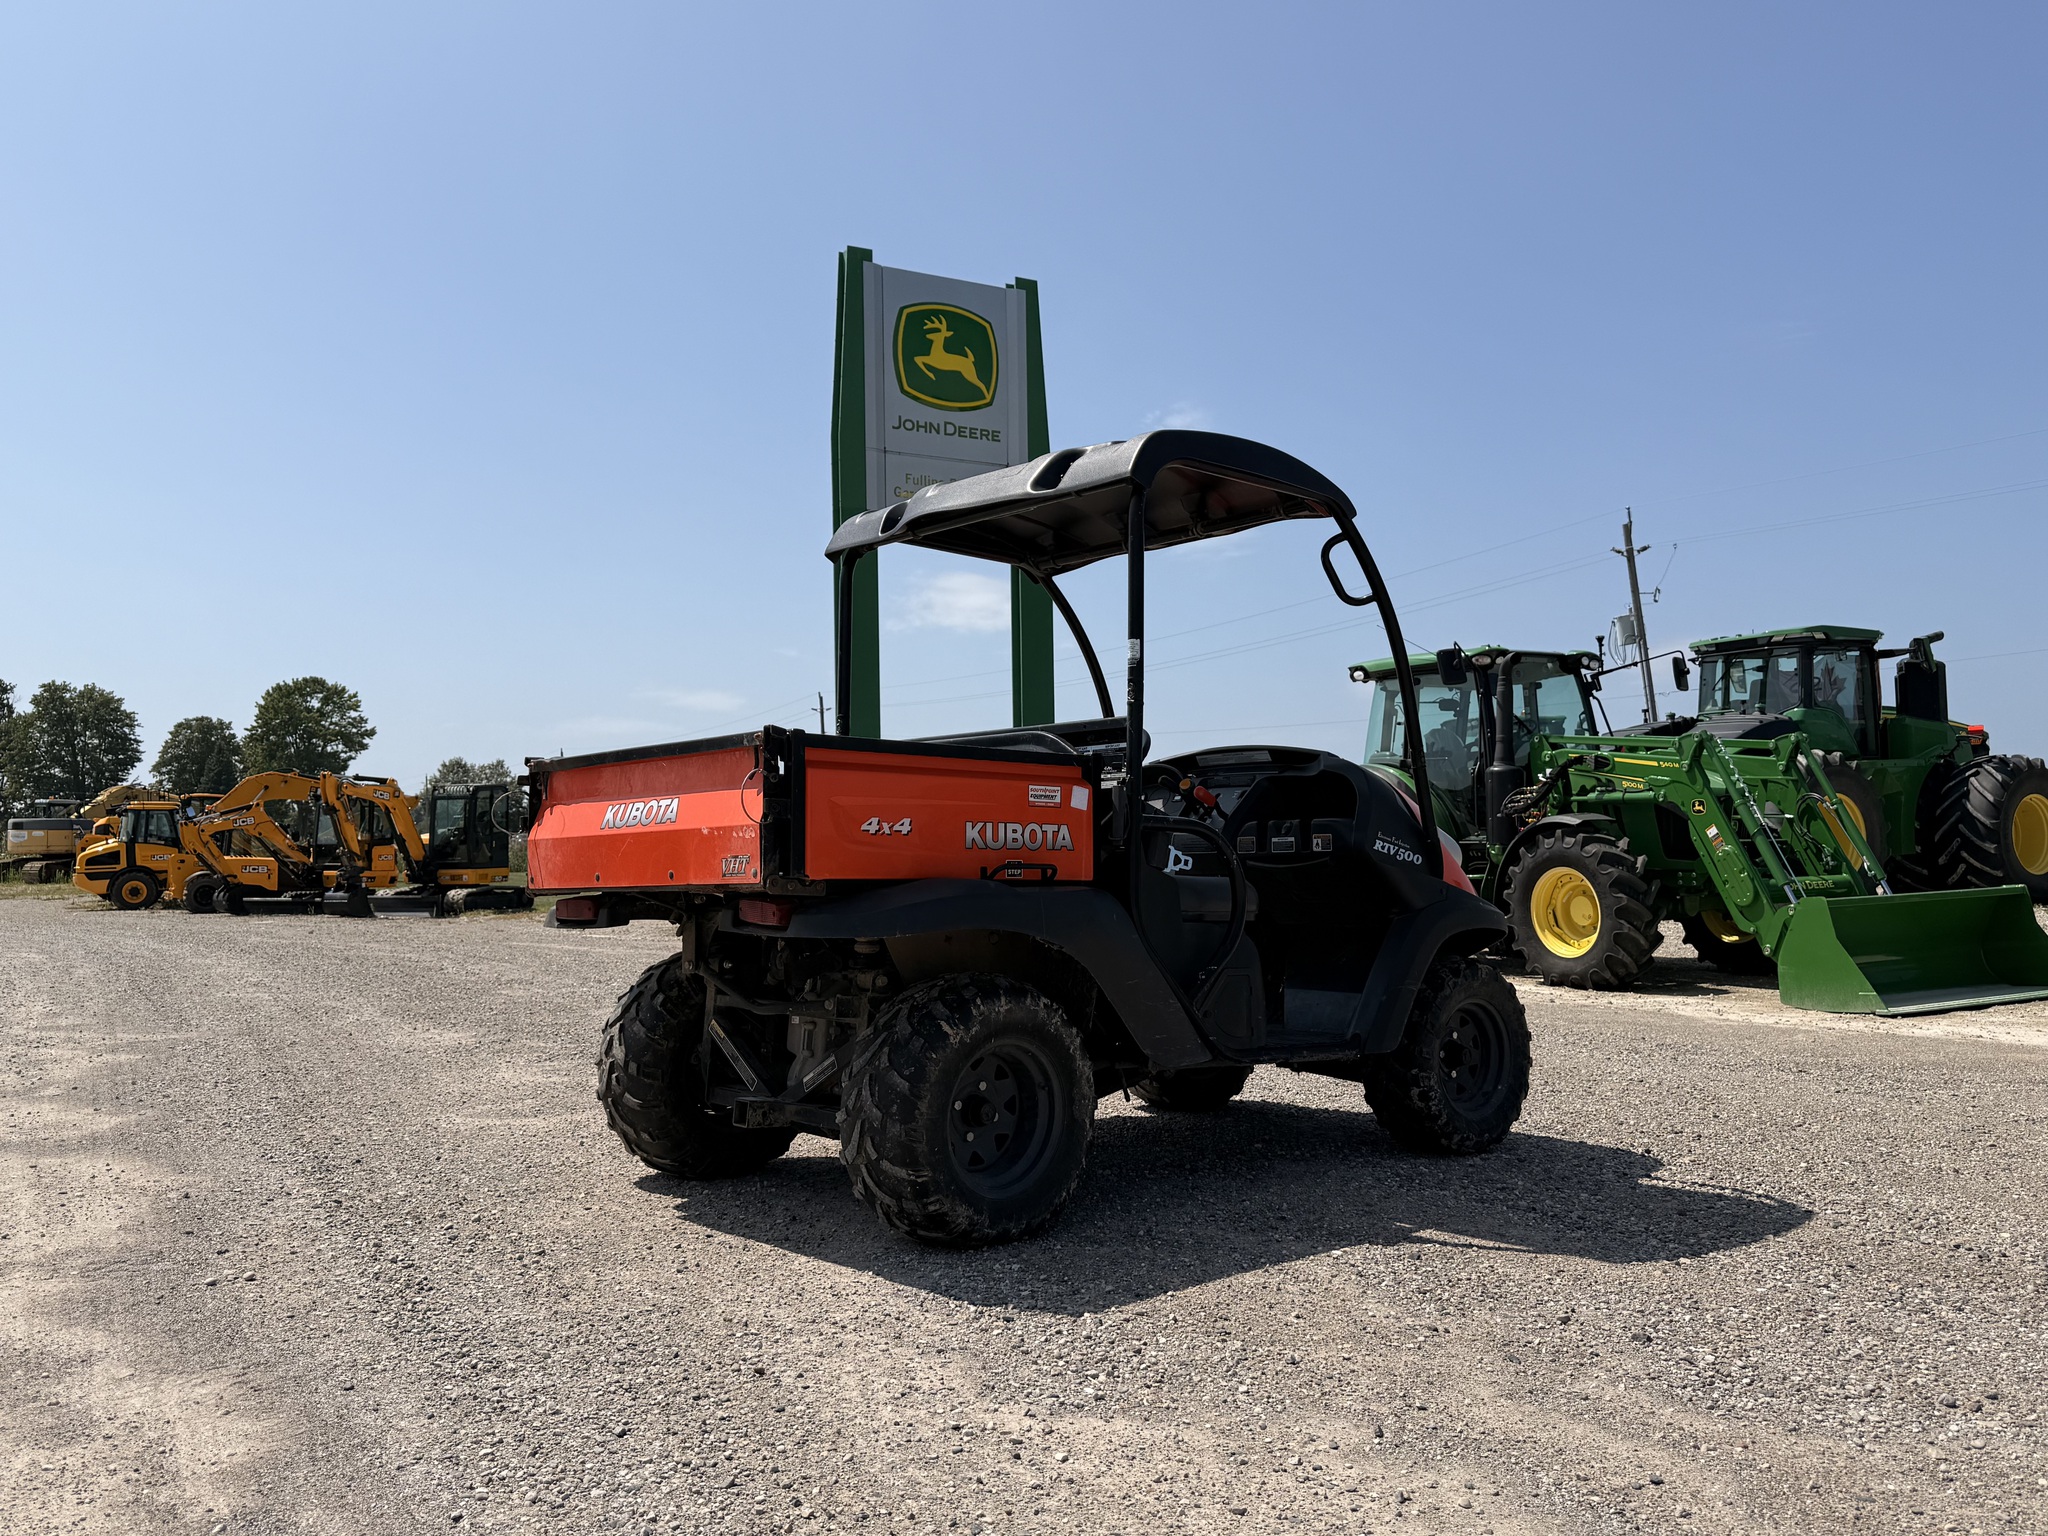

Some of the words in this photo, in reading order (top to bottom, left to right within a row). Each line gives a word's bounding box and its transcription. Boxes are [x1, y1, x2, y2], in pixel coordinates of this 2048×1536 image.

[892, 415, 940, 435] JOHN
[943, 421, 1001, 443] DEERE
[373, 790, 390, 800] JCB
[233, 816, 255, 827] JCB
[600, 797, 680, 830] KUBOTA
[860, 817, 912, 836] 4x4
[965, 820, 1075, 851] KUBOTA
[241, 865, 268, 873] JCB
[721, 858, 748, 874] VHT
[1805, 880, 1835, 890] DEERE
